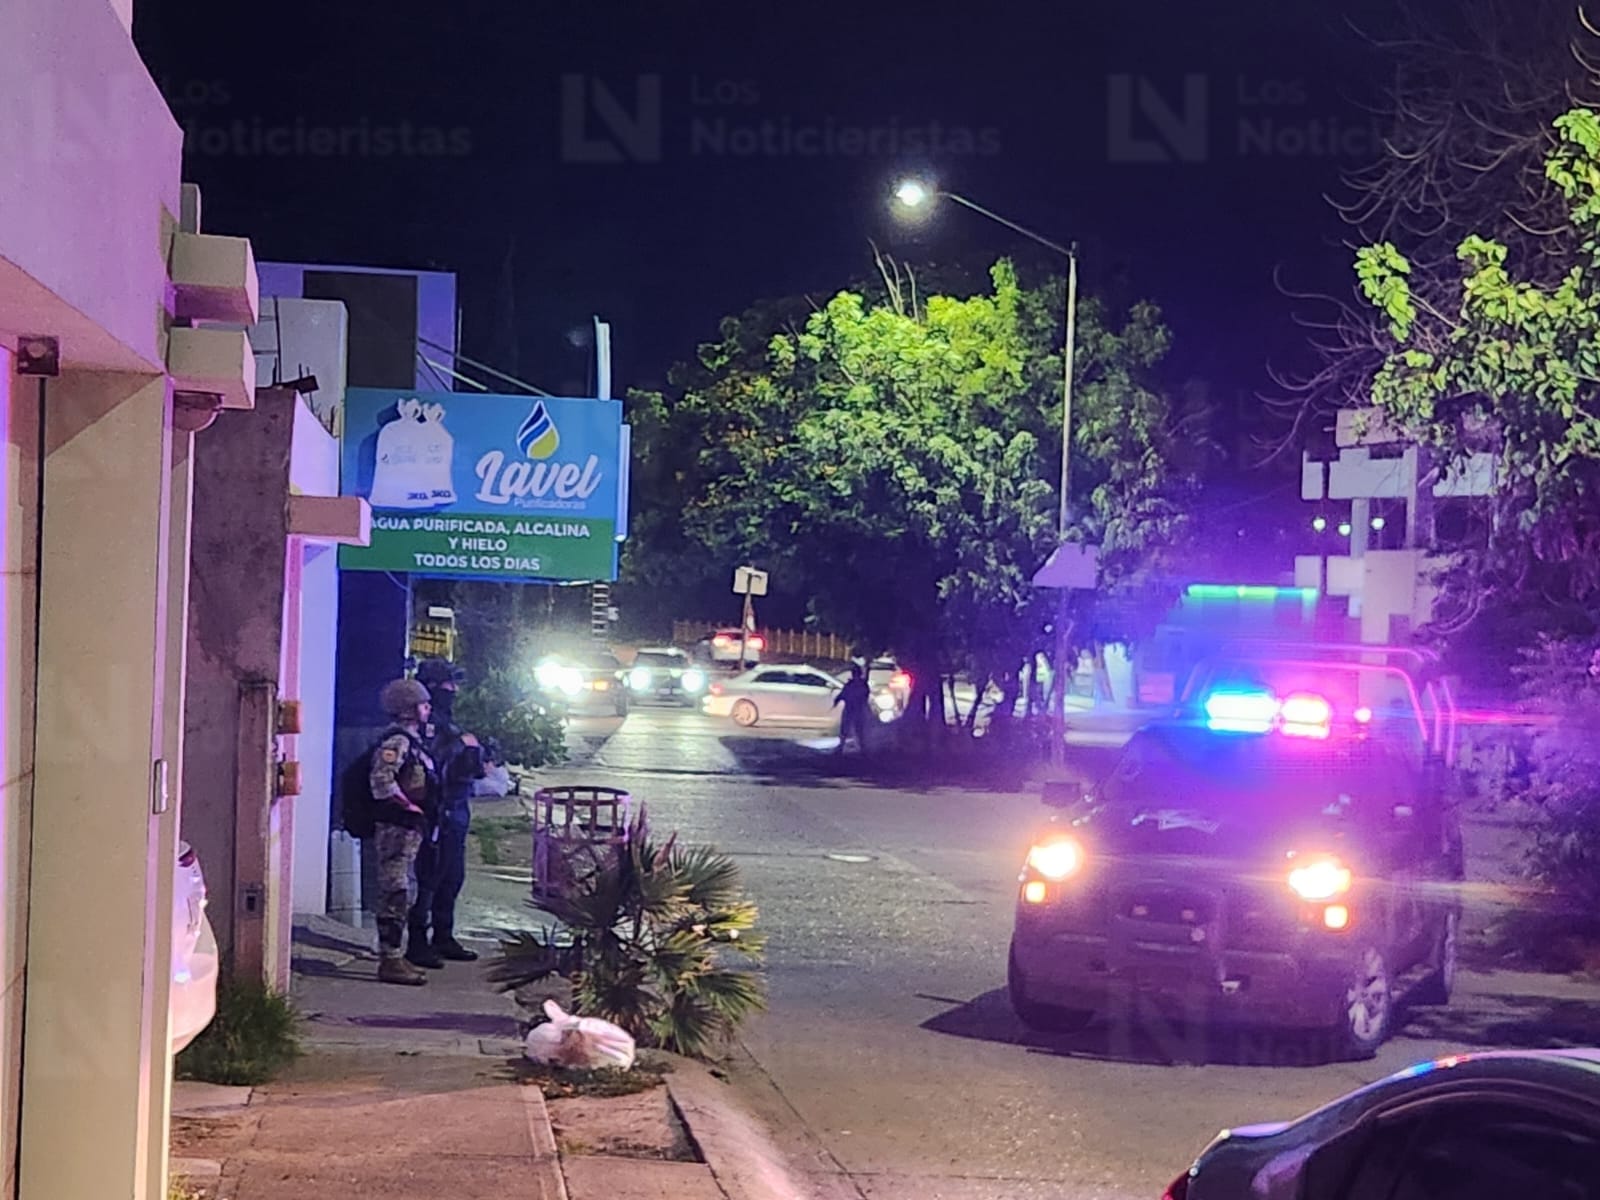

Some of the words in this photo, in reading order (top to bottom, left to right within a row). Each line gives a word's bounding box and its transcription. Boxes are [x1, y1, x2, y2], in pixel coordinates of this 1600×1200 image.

[475, 450, 602, 504] Lavel
[413, 517, 511, 536] PURIFICADA,
[512, 521, 590, 538] ALCALINA
[448, 537, 458, 550] Y
[462, 538, 508, 551] HIELO
[414, 553, 468, 569] TODOS
[471, 554, 501, 570] LOS
[504, 556, 541, 571] DIAS
